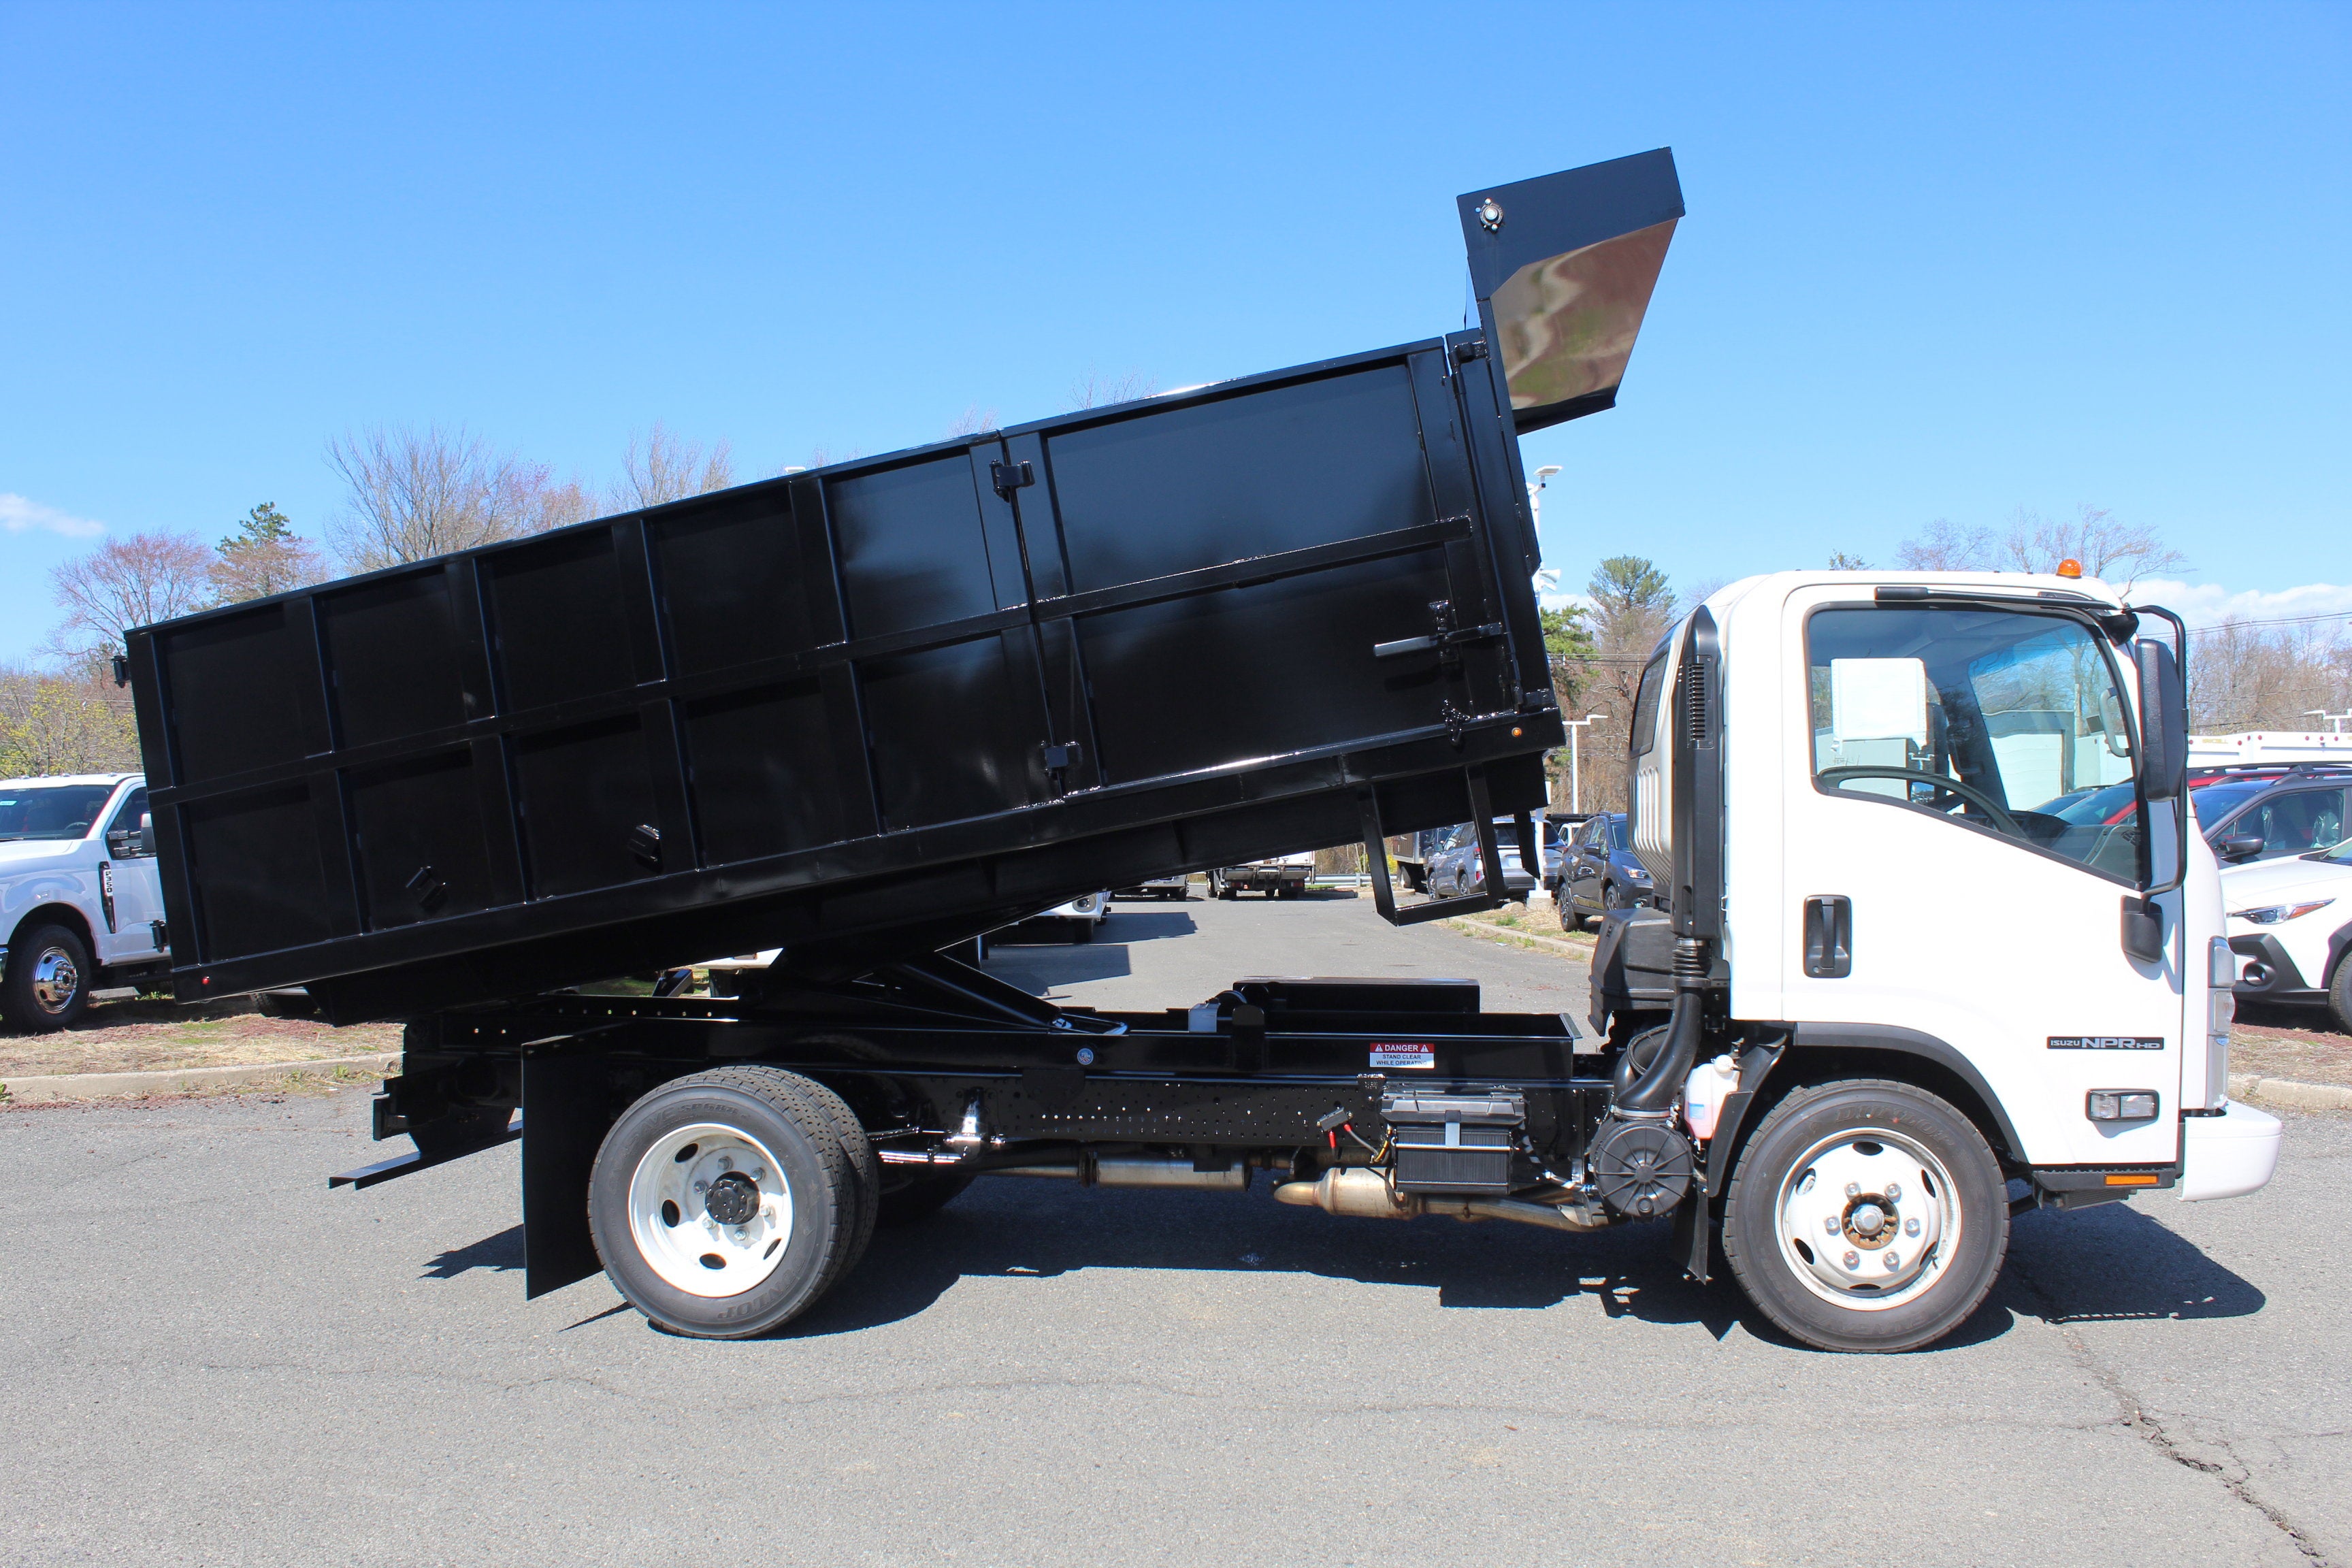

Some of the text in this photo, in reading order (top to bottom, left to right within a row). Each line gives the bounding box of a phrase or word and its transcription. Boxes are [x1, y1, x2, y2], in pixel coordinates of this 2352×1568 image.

[1384, 1044, 1419, 1052] DANGER
[1836, 1105, 1955, 1146] DUNLOP
[717, 1250, 806, 1319] DUNLOP
